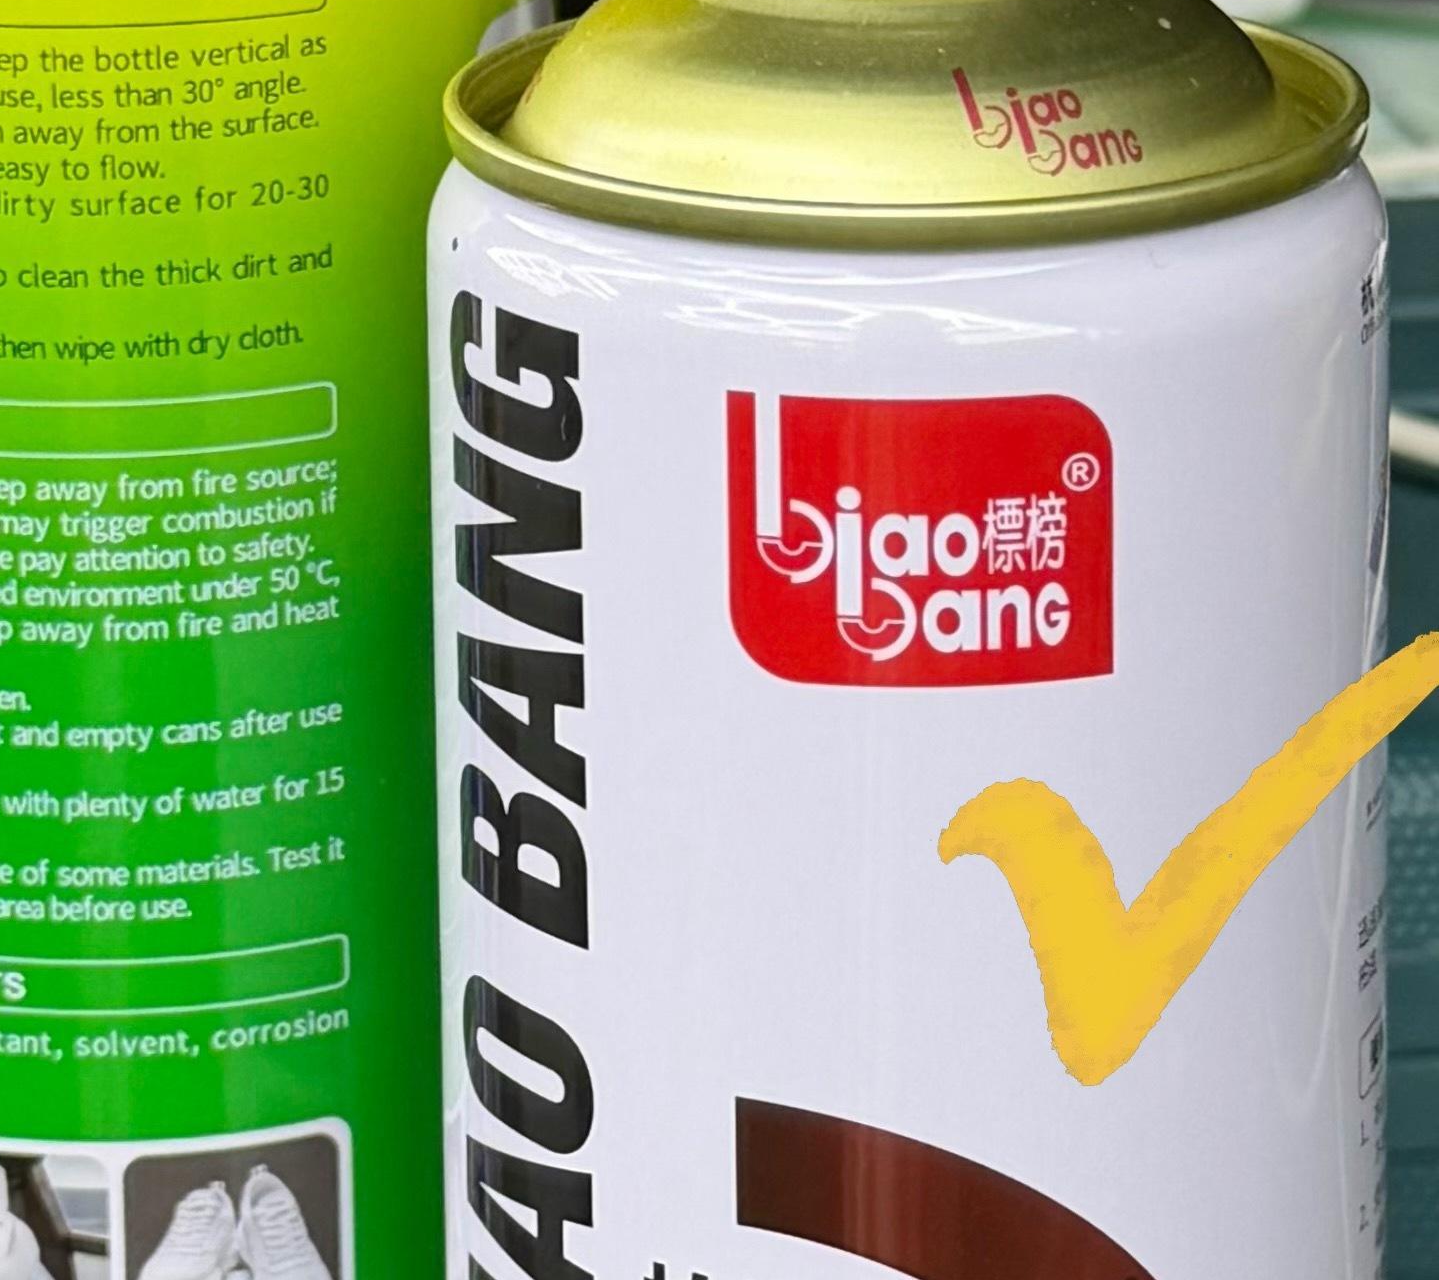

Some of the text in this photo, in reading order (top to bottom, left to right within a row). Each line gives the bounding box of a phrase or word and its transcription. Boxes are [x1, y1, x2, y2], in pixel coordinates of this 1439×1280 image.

[40, 48, 83, 72] the
[95, 45, 179, 71] bottle
[191, 34, 289, 66] vertical
[301, 37, 326, 56] as
[14, 126, 83, 151] away
[96, 118, 159, 143] from
[170, 116, 212, 140] the
[223, 108, 318, 137] surface.
[71, 190, 180, 216] surface
[195, 186, 237, 211] for
[252, 174, 328, 206] 20-30
[60, 512, 153, 542] trigger
[162, 498, 314, 533] combustion
[321, 486, 337, 514] if
[981, 489, 1067, 575] 標榜
[23, 581, 184, 606] environment
[191, 573, 262, 601] under
[270, 566, 299, 593] 50
[451, 289, 589, 951] BANG
[11, 721, 59, 747] and
[65, 724, 153, 753] empty
[161, 722, 222, 744] cans
[230, 709, 292, 738] after
[300, 703, 342, 728] use
[19, 859, 49, 885] of
[57, 866, 130, 886] some
[136, 851, 260, 884] materials.
[267, 842, 321, 871] Test
[329, 837, 345, 861] it
[75, 1031, 199, 1057] solvent,
[211, 1009, 349, 1050] corrosion
